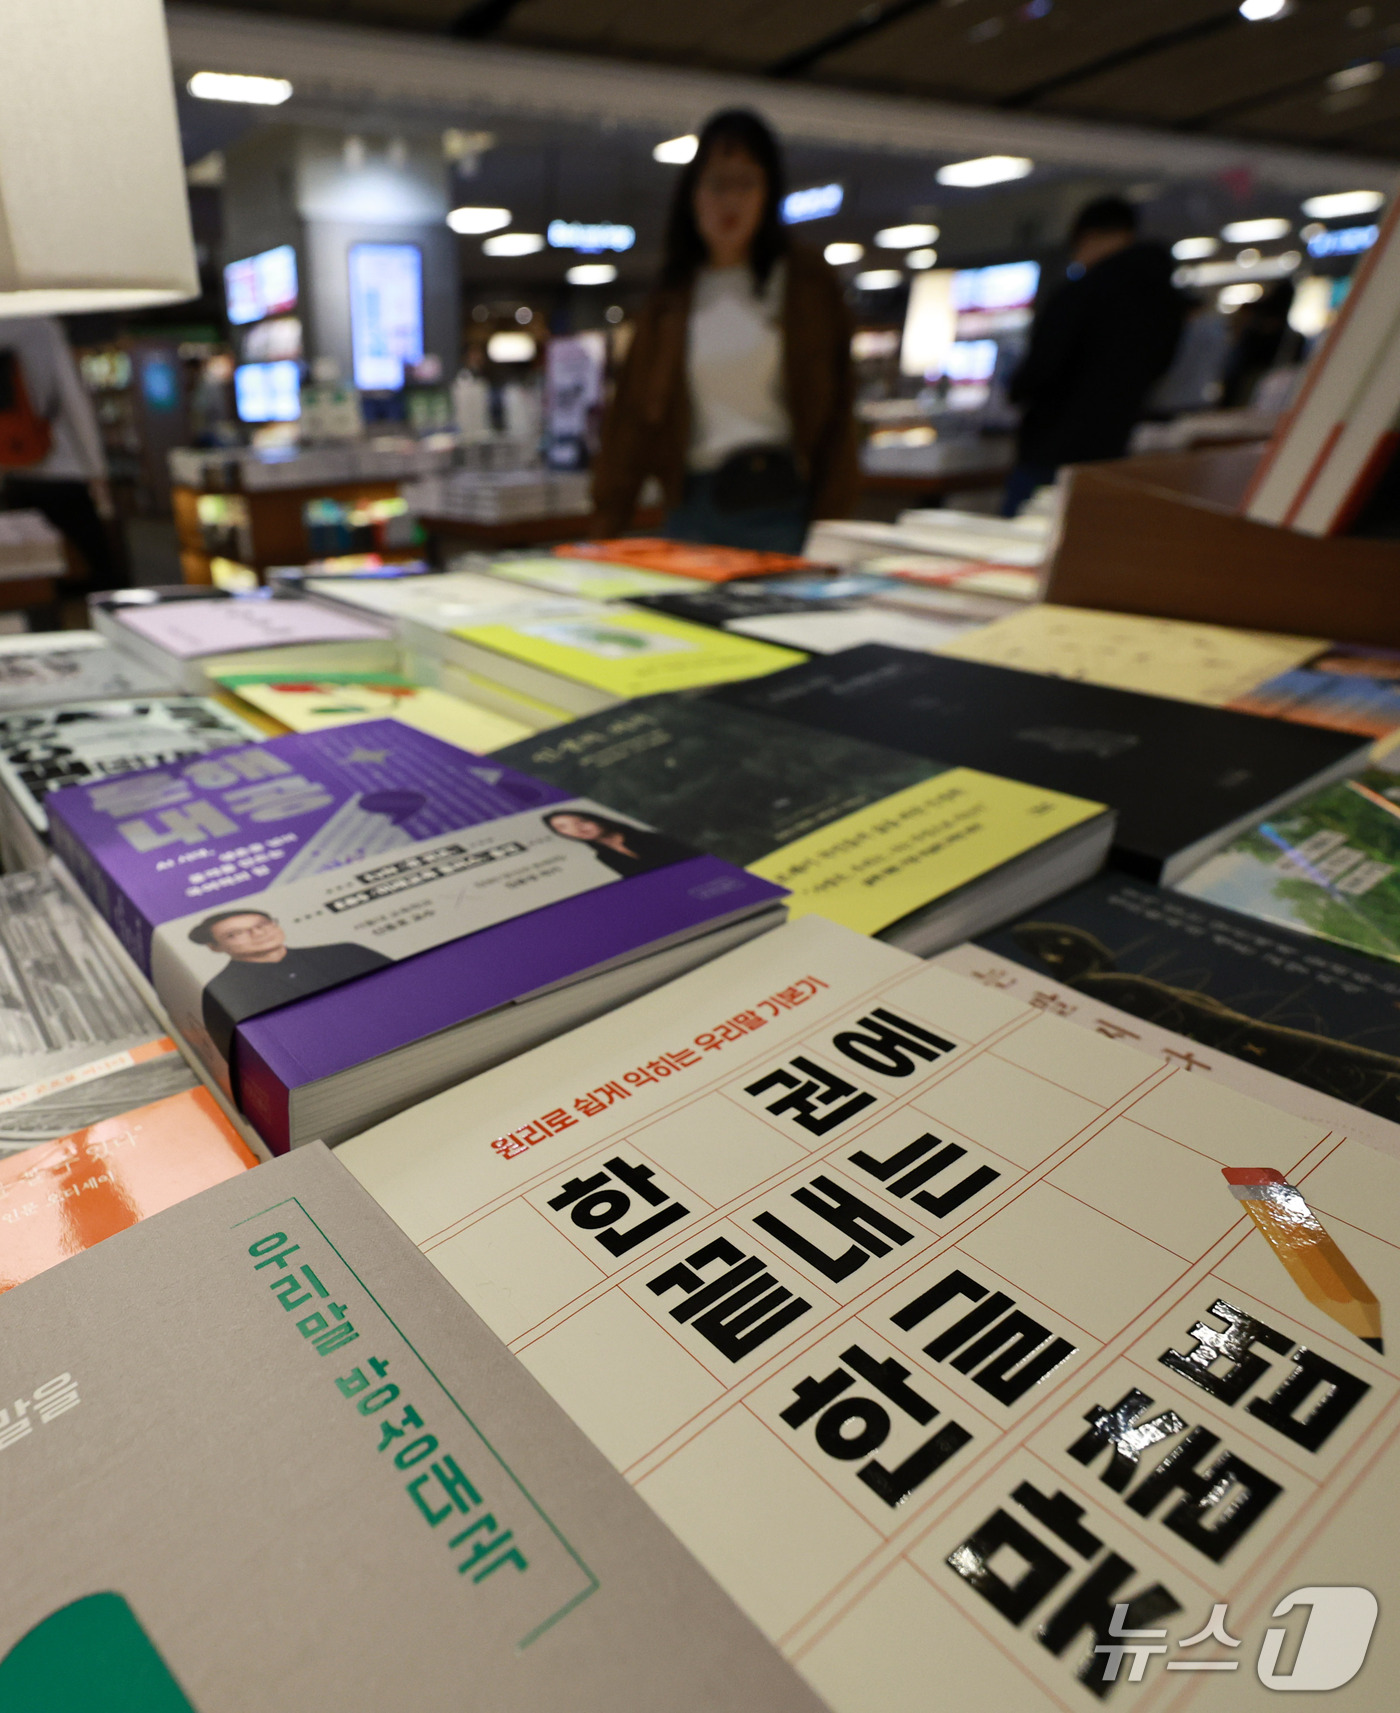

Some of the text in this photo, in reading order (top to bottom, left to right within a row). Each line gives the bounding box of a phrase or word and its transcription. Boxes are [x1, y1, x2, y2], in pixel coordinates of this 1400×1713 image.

[490, 974, 829, 1160] 원리로 쉽게 익히는 우리말 기본기
[546, 1156, 691, 1258] 한
[743, 1007, 957, 1137] 권에
[248, 1231, 360, 1357] 우리말
[645, 1132, 1001, 1364] 끝내는
[779, 1269, 1080, 1509] 한글
[945, 1299, 1372, 1702] 맞춤법
